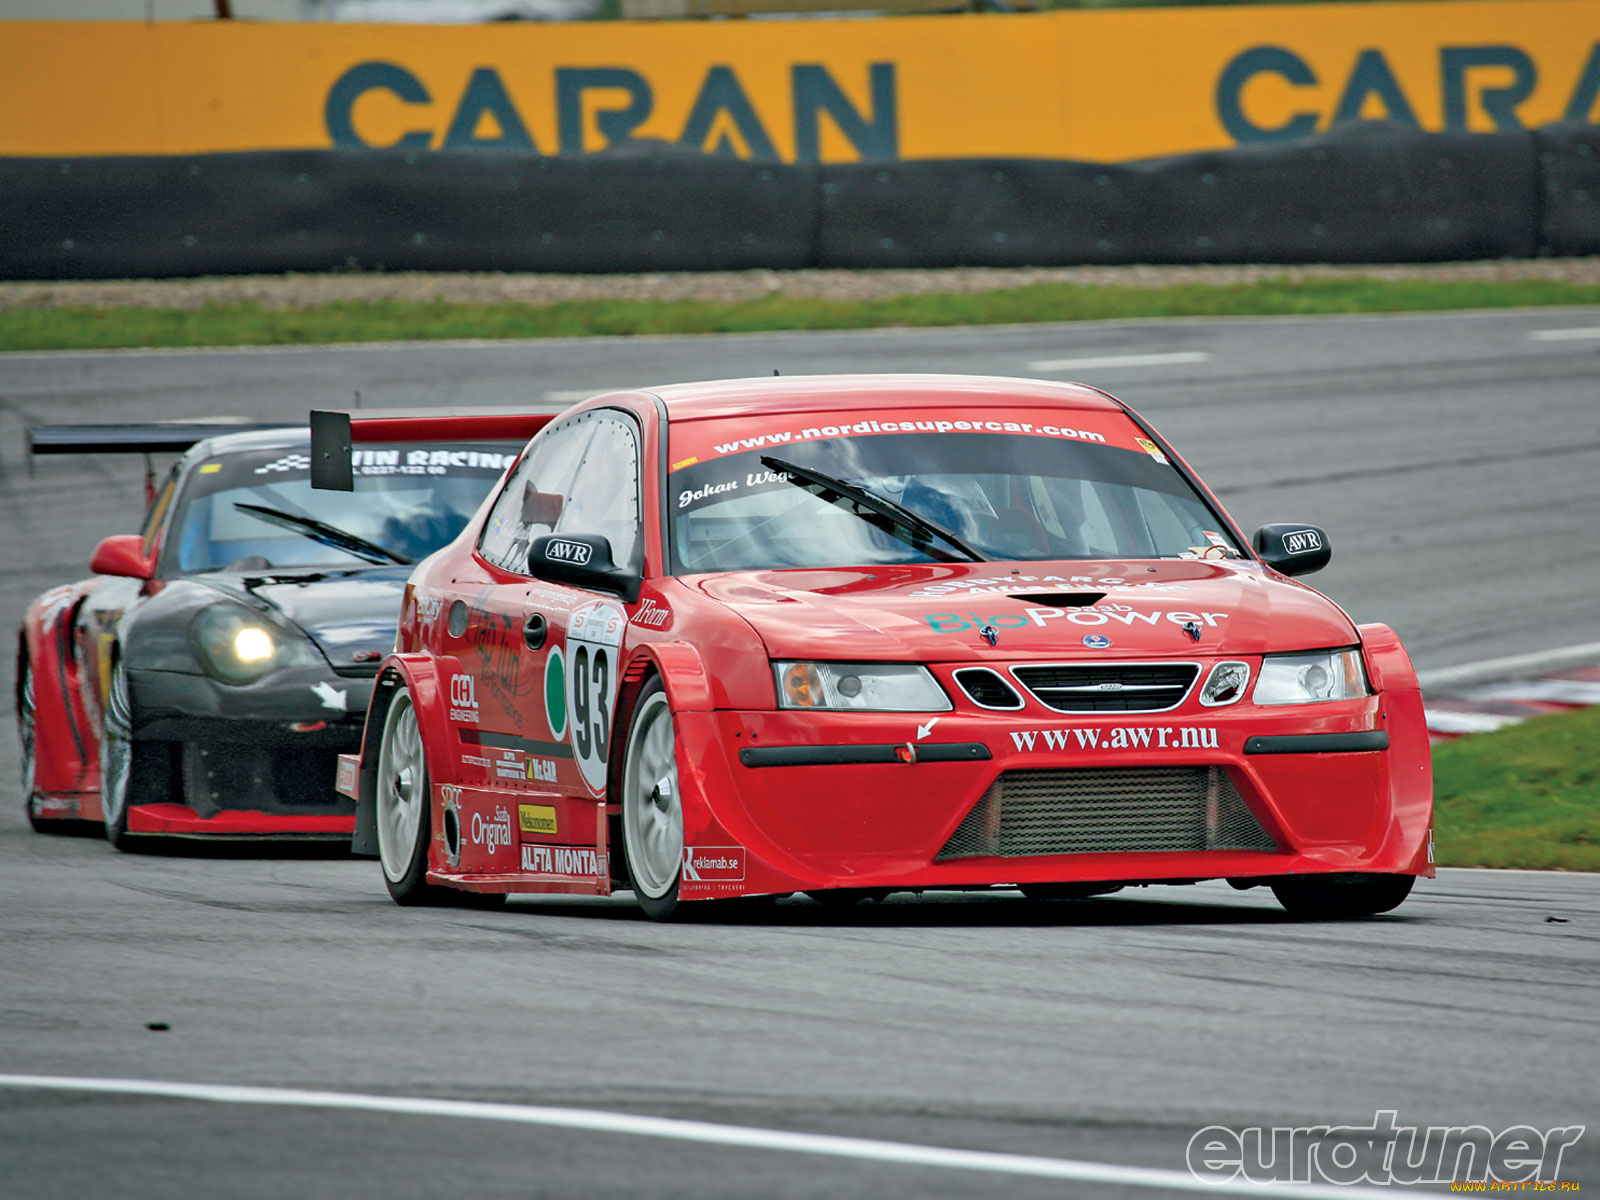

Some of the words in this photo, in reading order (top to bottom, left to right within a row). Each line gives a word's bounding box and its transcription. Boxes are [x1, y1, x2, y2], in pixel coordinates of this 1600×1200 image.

[325, 61, 897, 164] CARAN
[714, 420, 1106, 454] www.nordicsupercar.com
[679, 480, 738, 508] Johan
[548, 542, 587, 562] AWR
[1288, 533, 1320, 552] AWR
[631, 598, 669, 626] XForm
[923, 606, 1229, 634] BioPower
[574, 645, 609, 764] 93
[1009, 727, 1219, 752] www.awr.nu
[471, 812, 512, 855] Original
[521, 846, 553, 872] ALFTA
